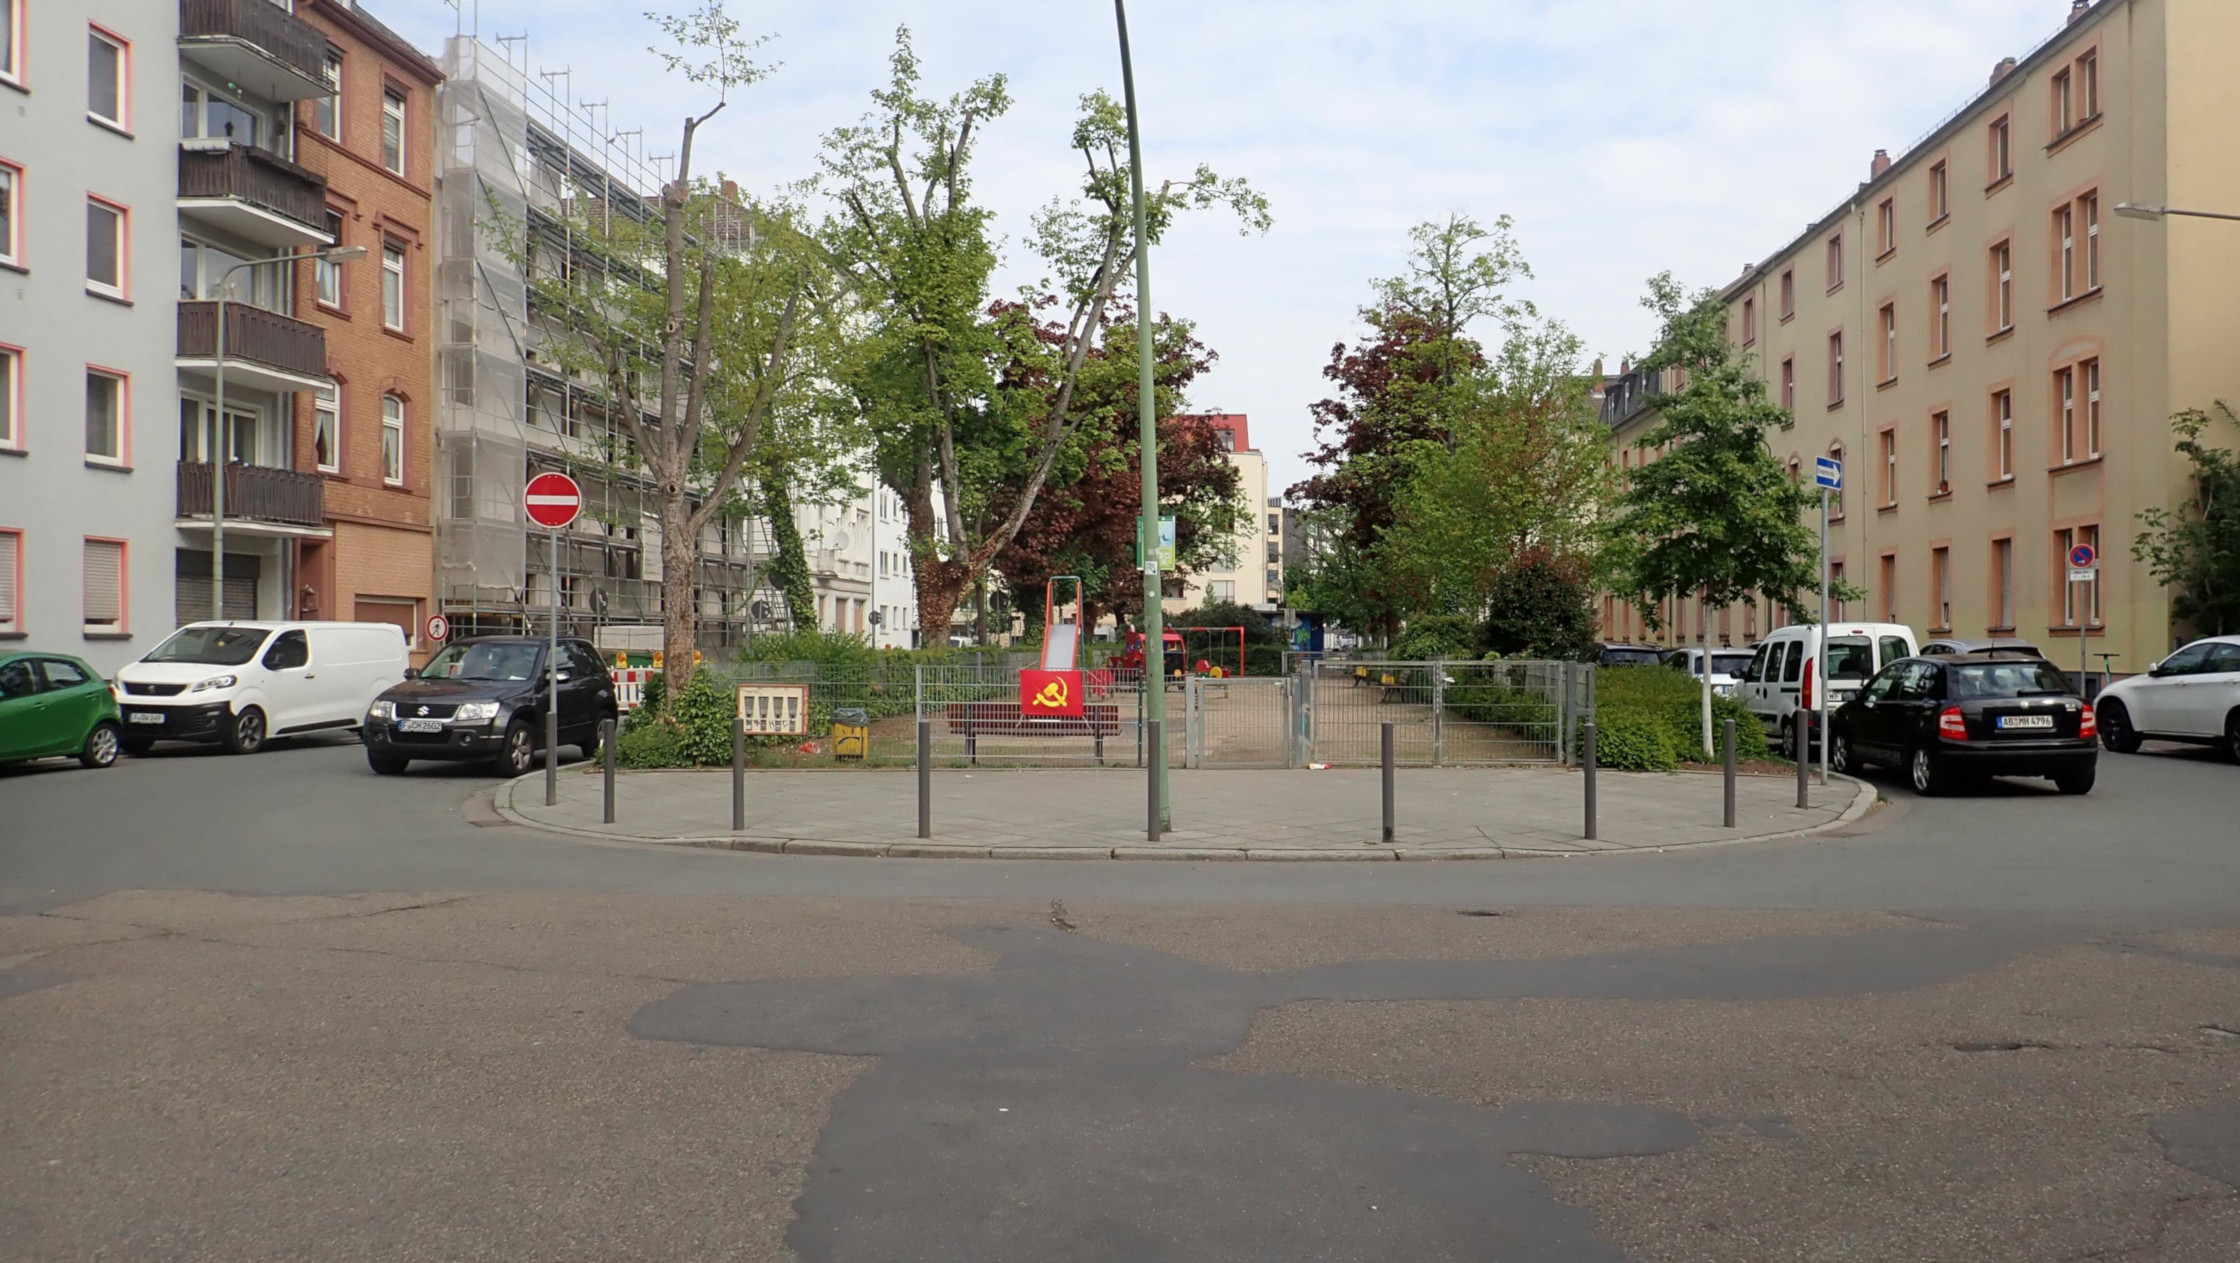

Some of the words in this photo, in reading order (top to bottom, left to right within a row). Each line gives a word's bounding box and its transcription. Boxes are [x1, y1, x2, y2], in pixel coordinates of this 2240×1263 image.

[412, 721, 422, 729] CH
[423, 722, 441, 730] 2602
[2003, 717, 2014, 726] AB
[2018, 717, 2030, 726] MH
[2031, 717, 2051, 726] 4796
